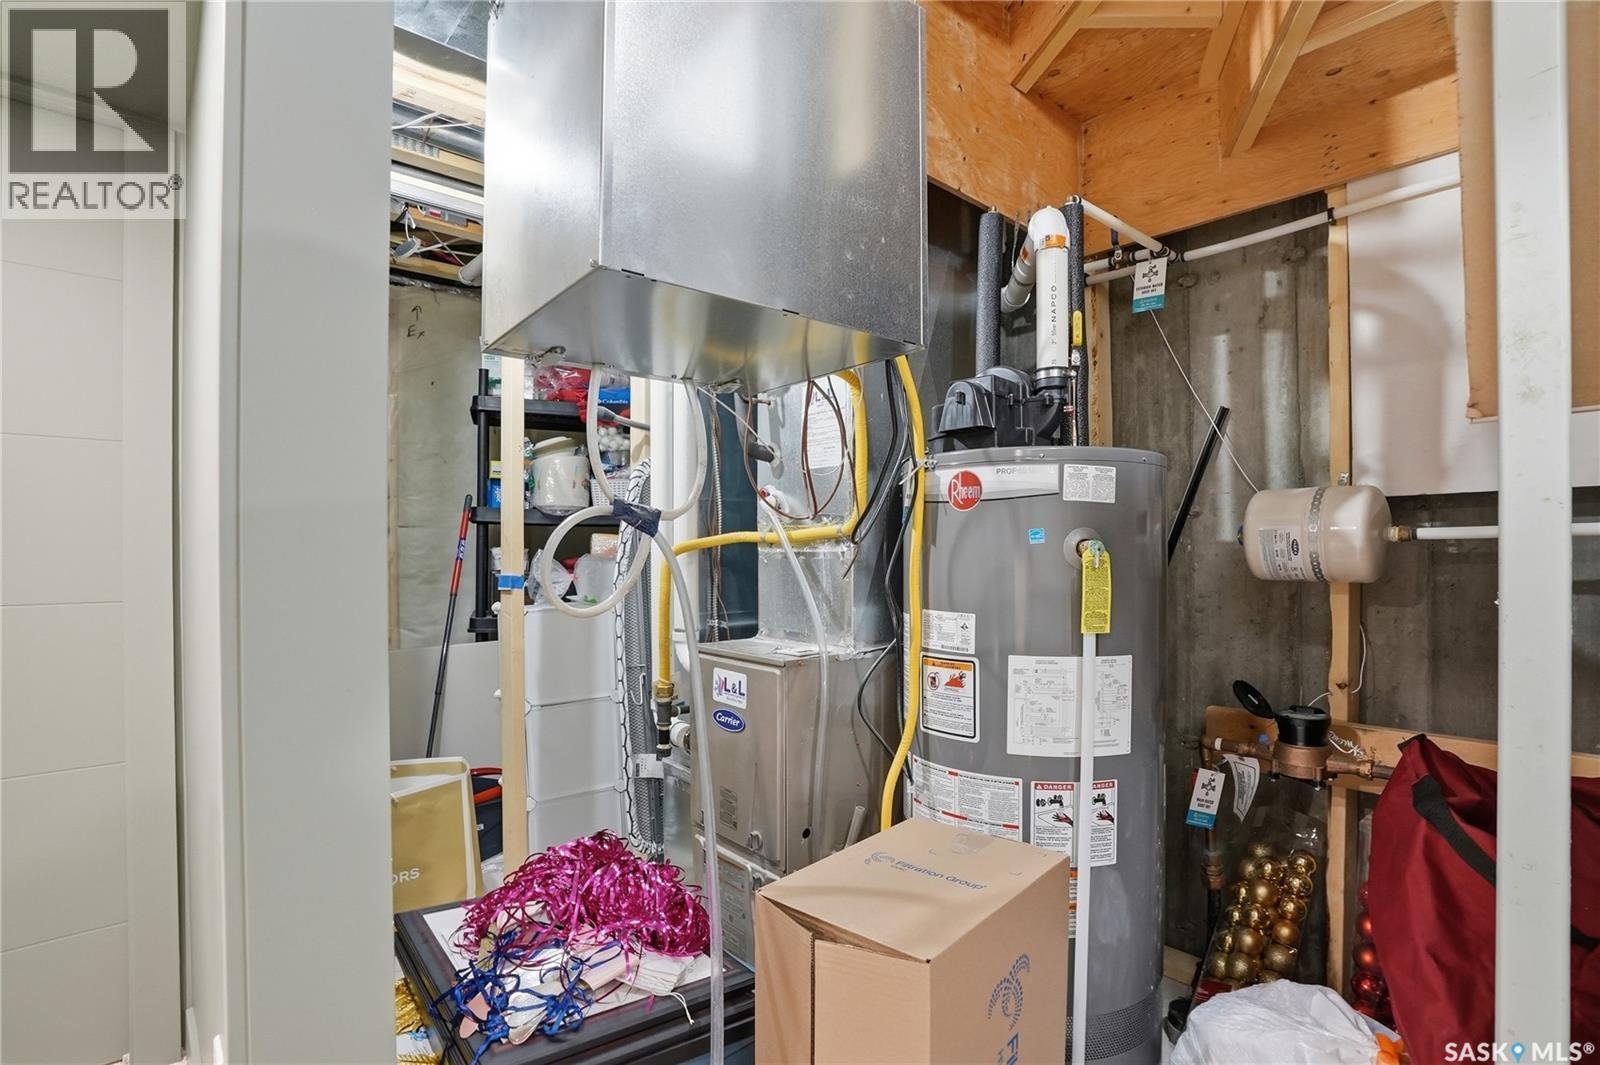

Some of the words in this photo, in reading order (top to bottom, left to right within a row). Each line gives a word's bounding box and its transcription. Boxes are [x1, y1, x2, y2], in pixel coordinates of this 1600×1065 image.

[407, 324, 425, 340] Ex
[951, 472, 980, 504] Rheem
[716, 712, 740, 727] Carrier
[895, 860, 944, 880] Filtration
[946, 874, 985, 891] Group
